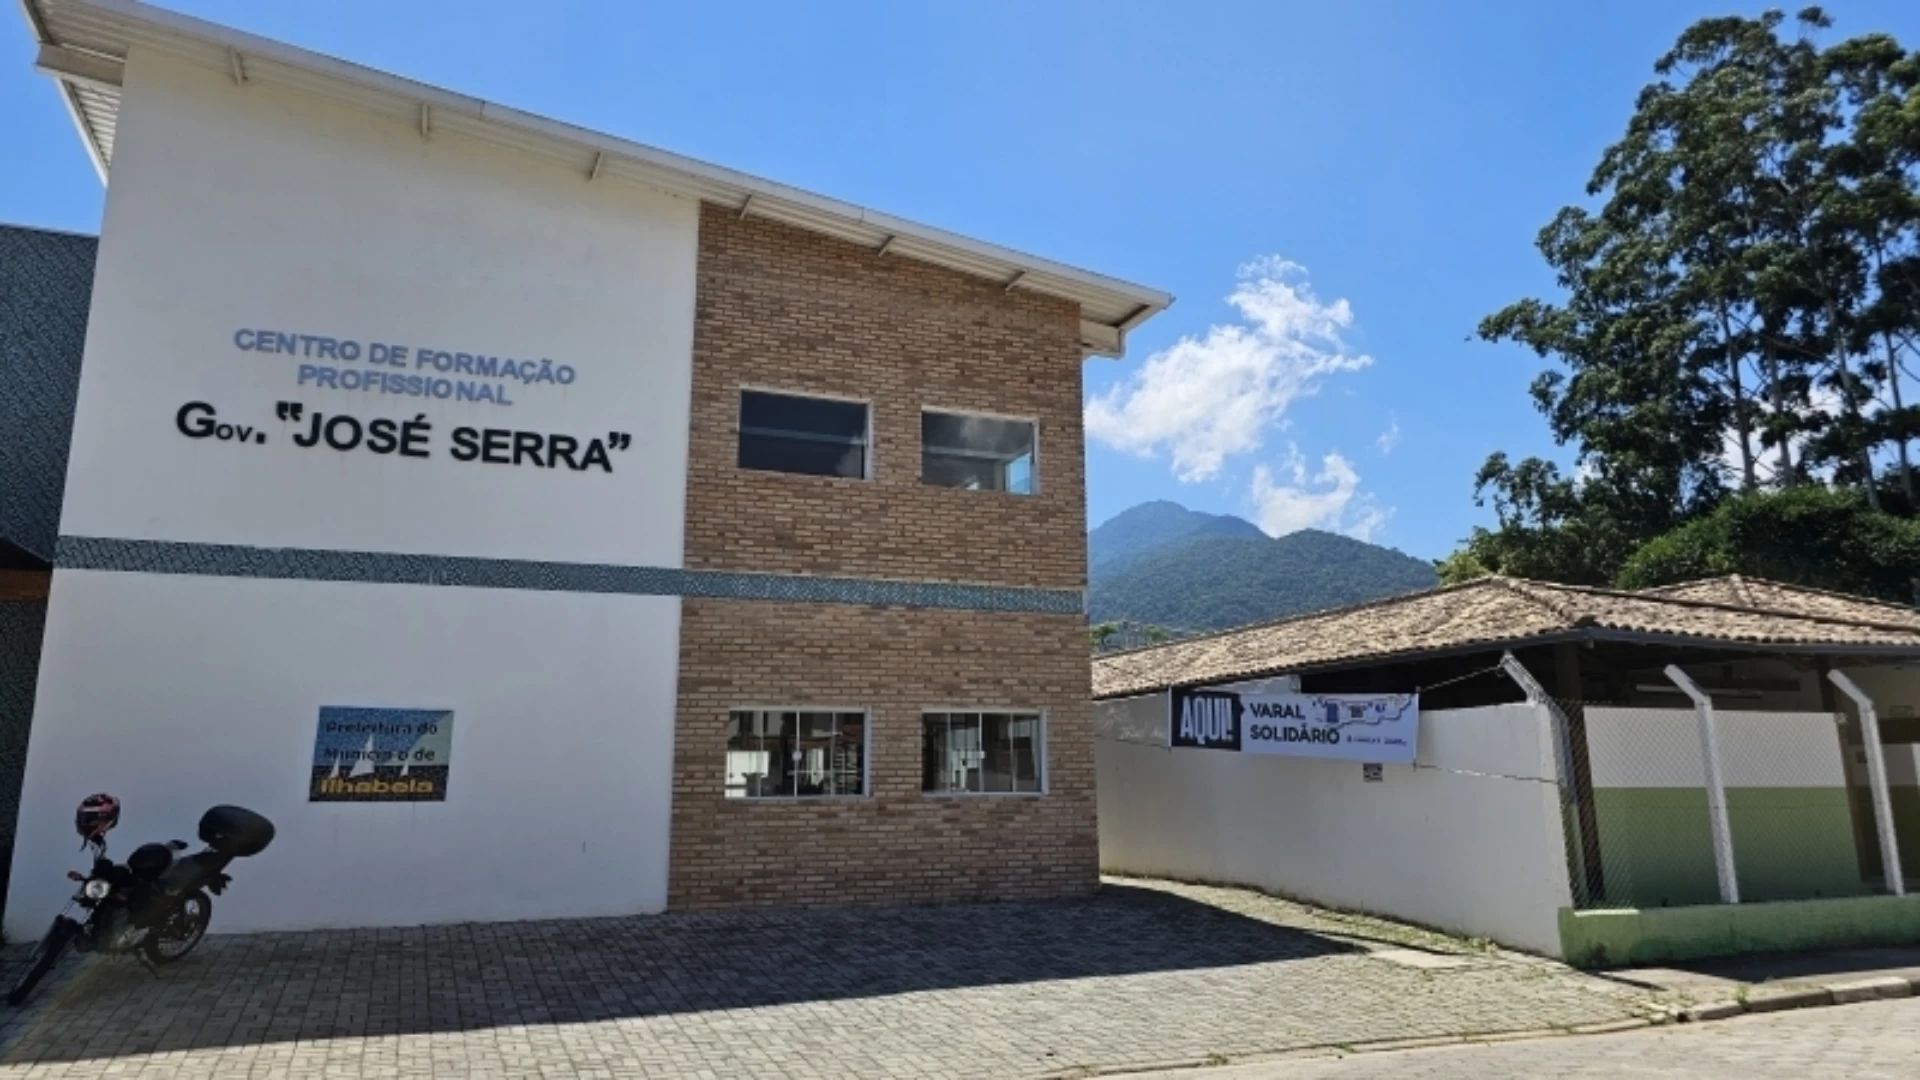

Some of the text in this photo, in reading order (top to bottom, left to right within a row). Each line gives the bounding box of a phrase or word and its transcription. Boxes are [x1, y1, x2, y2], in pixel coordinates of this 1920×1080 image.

[233, 327, 576, 385] CENTRO DE FORMAÇÃO
[297, 364, 514, 406] PROFISSIONAL
[1179, 695, 1234, 745] AQUI!
[1250, 702, 1306, 721] VARAL
[325, 719, 438, 736] Prefeitura do
[1250, 723, 1341, 745] SOLIDÁRIO
[414, 745, 436, 762] de
[320, 778, 434, 794] Ilhabela
